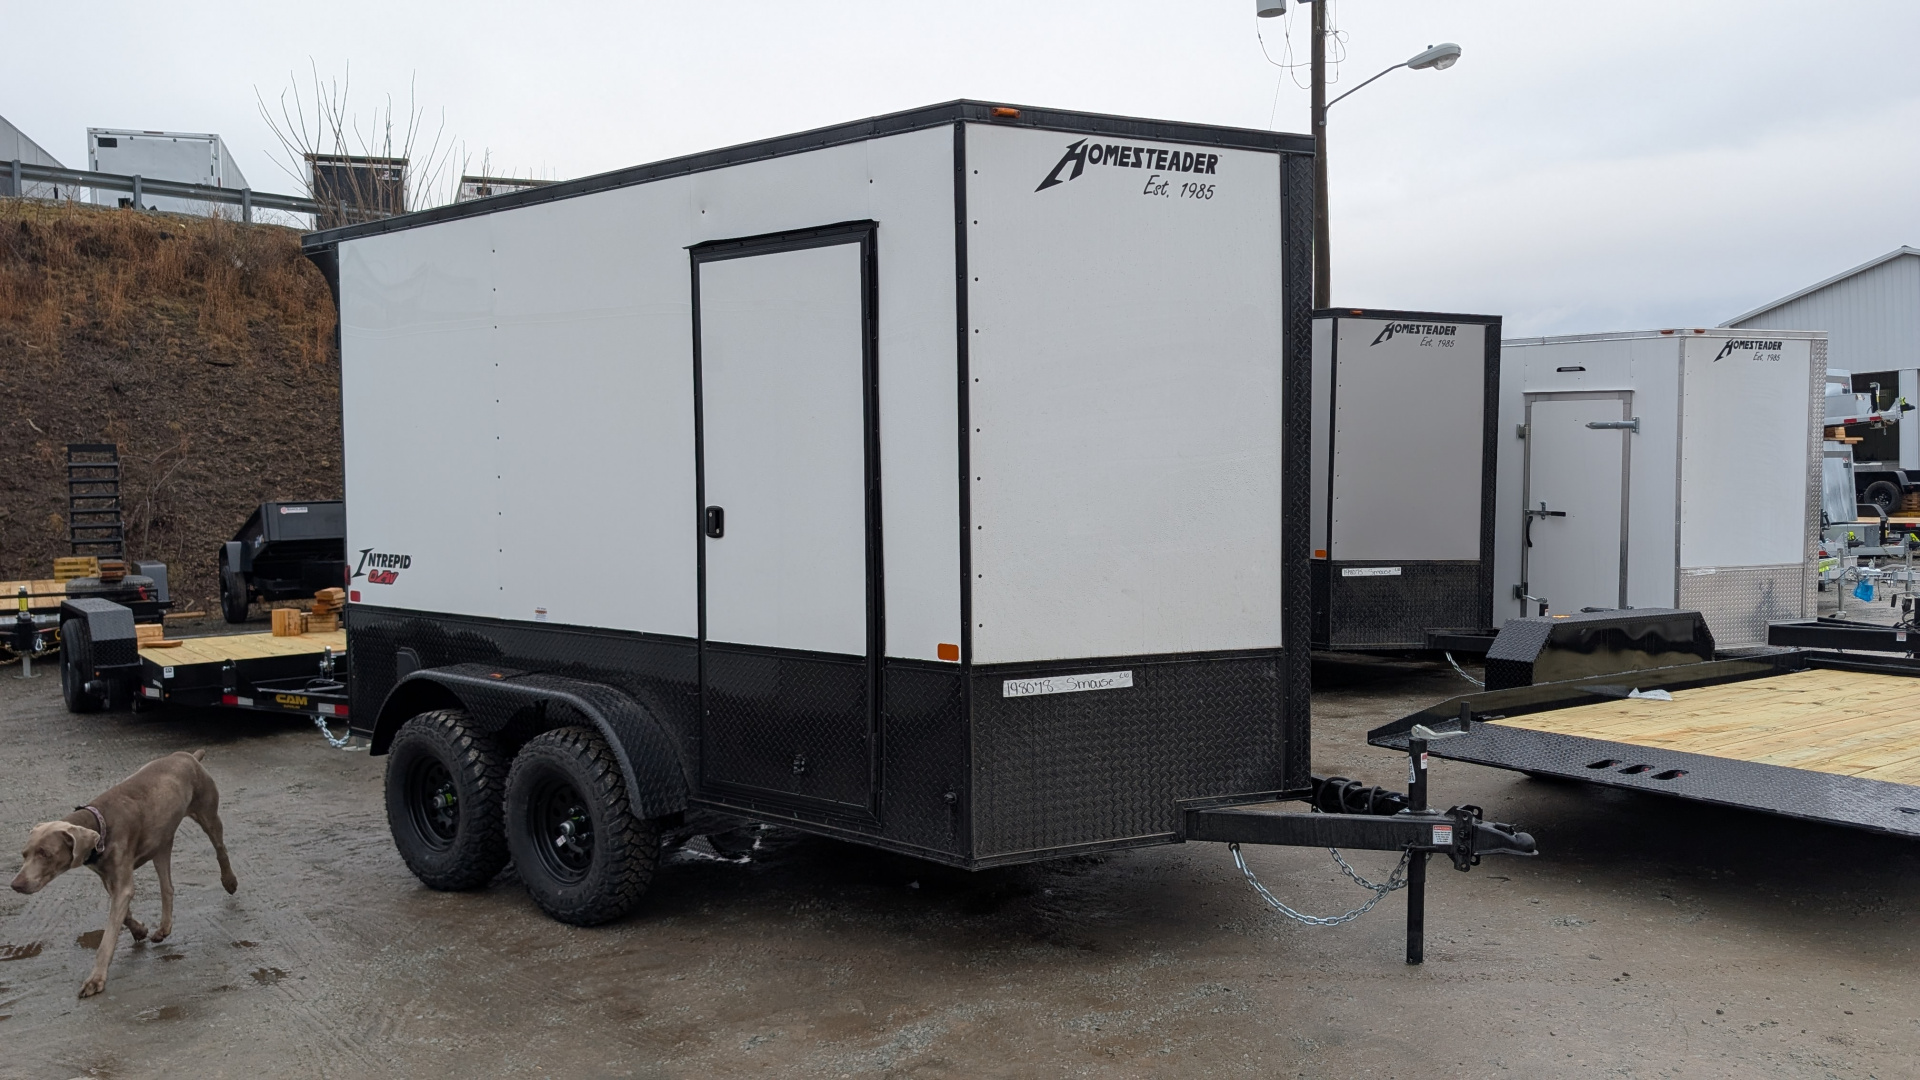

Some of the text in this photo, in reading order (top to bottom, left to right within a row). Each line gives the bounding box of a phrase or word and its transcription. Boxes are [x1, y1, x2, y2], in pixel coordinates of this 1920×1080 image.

[1034, 138, 1219, 193] HOMESTEADER
[1143, 174, 1216, 200] Est. 1985
[1370, 321, 1457, 347] HOMESTEADER
[1437, 339, 1456, 348] 1985
[1713, 338, 1783, 362] HOMESTEADER
[351, 547, 412, 578] INTREPID
[275, 694, 308, 706] CAM
